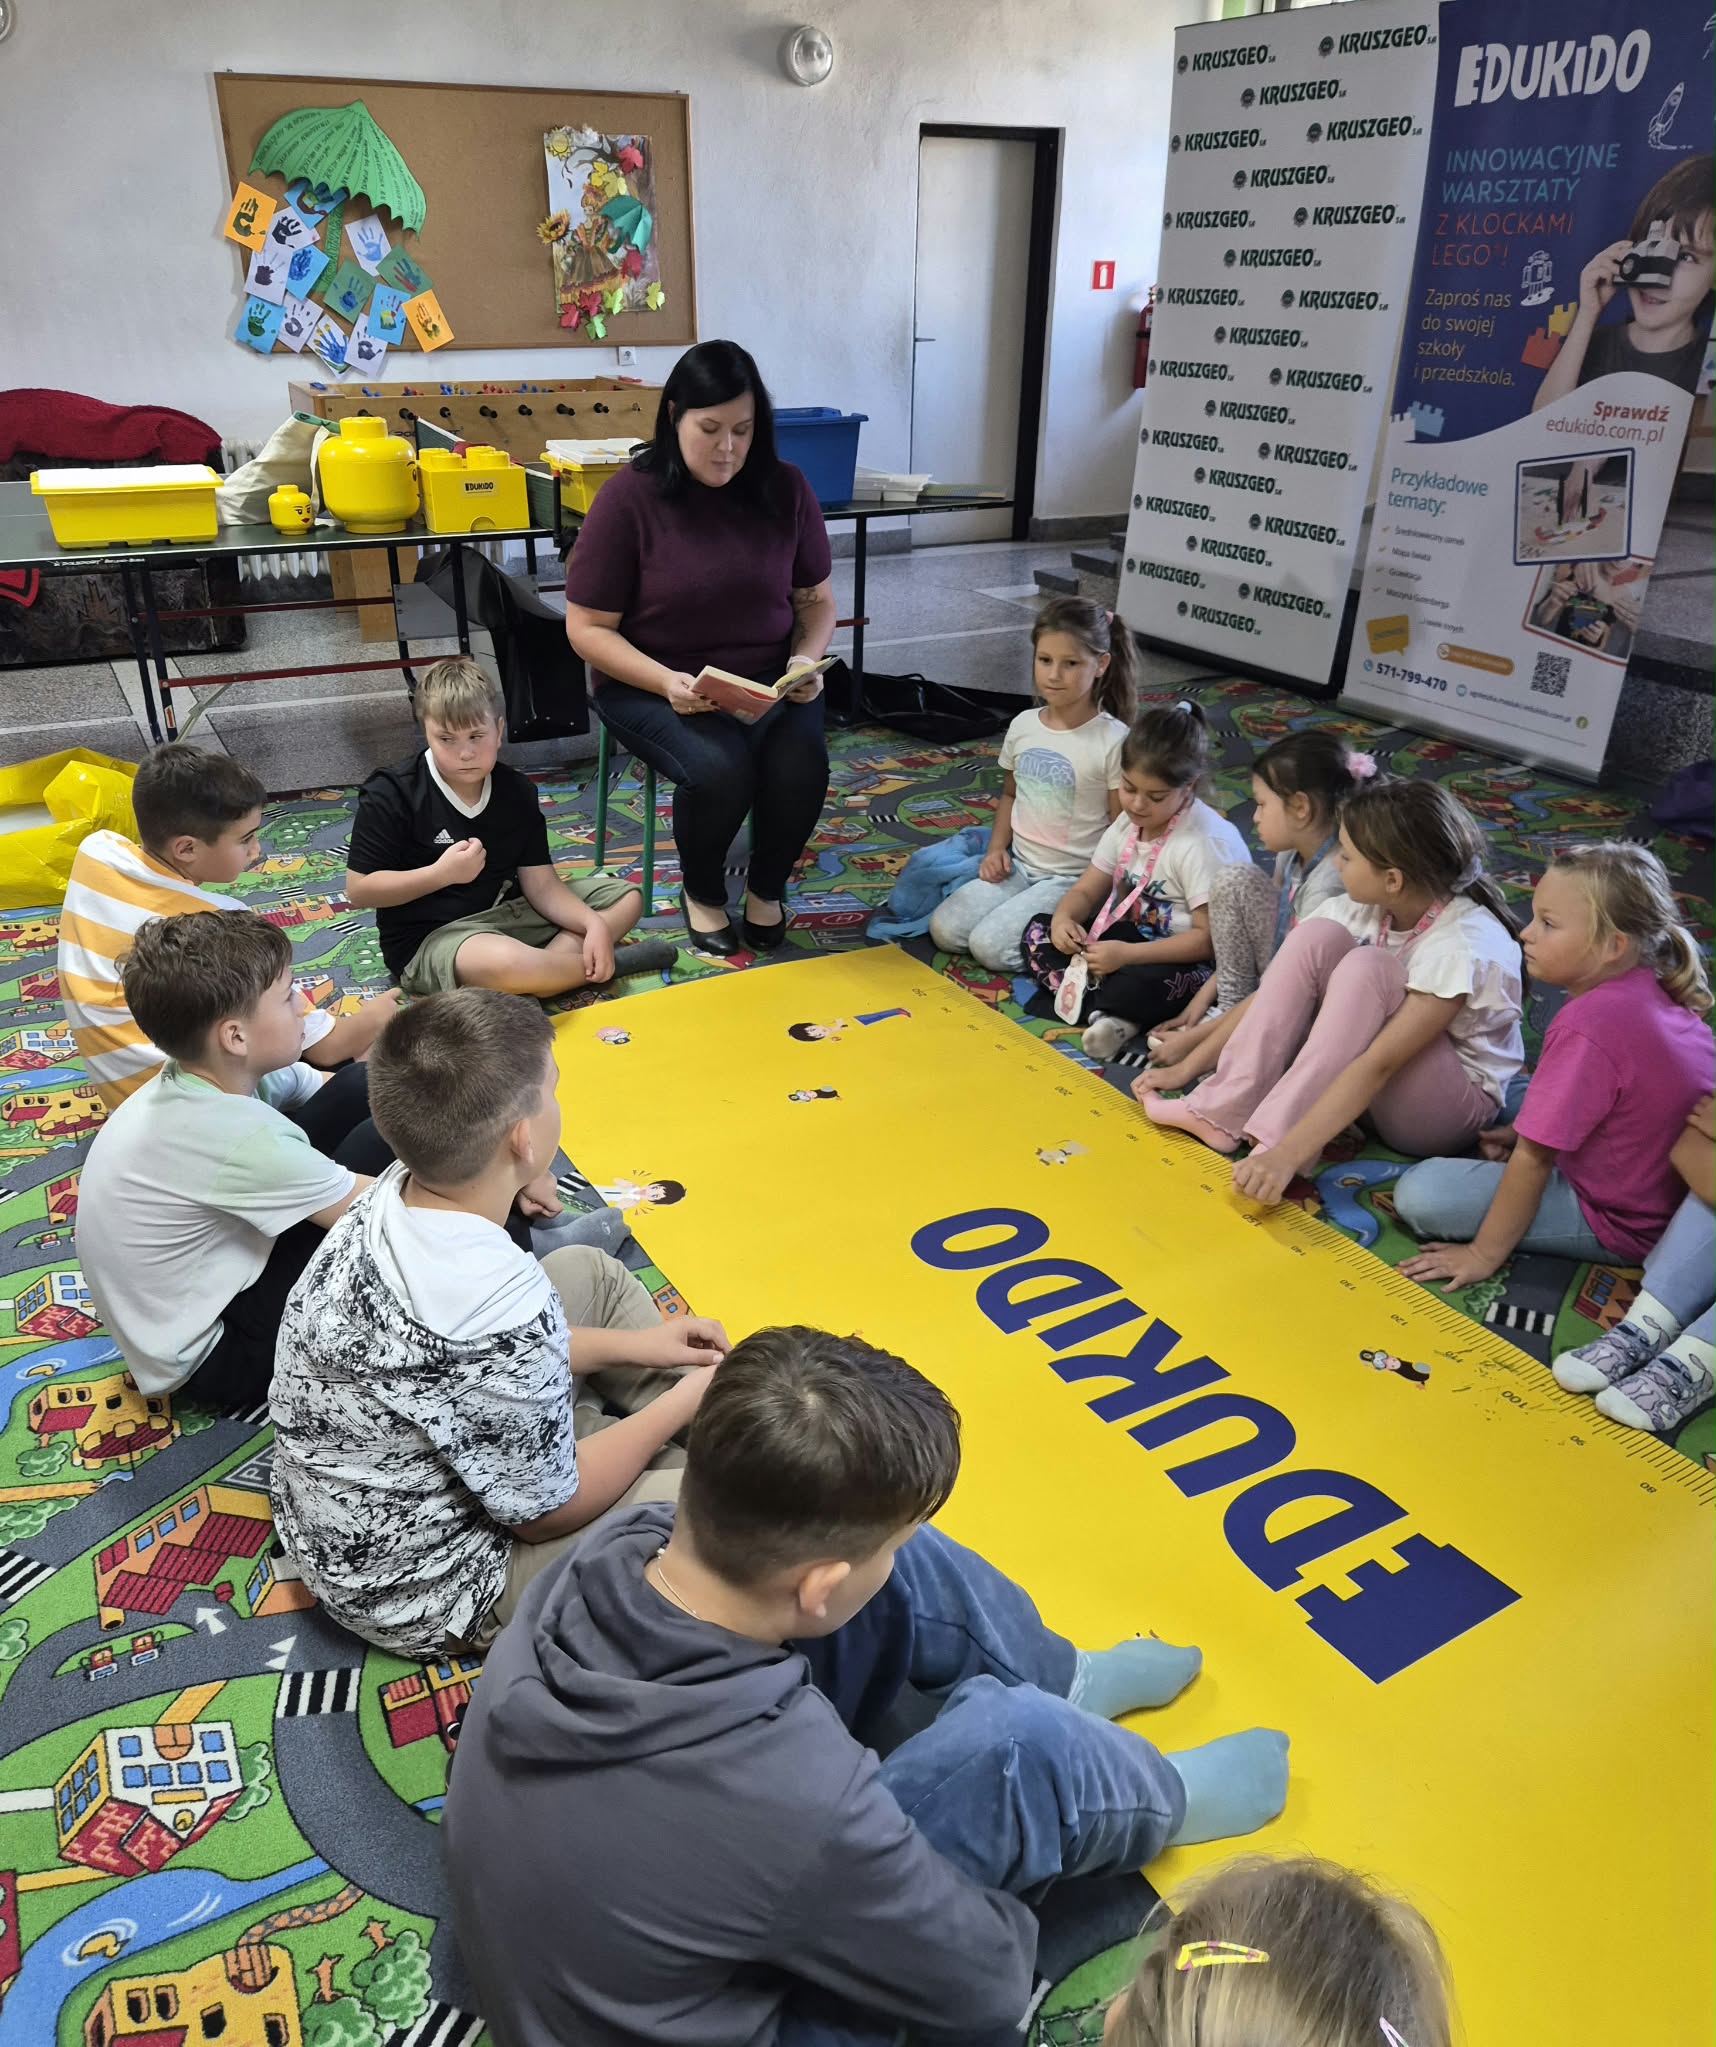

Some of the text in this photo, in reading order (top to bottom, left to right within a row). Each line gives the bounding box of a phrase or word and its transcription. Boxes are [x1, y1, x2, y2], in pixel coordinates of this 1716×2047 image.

[1339, 25, 1427, 54] KRUSZGEO
[1193, 45, 1268, 71] KRUSZGEO
[1454, 29, 1651, 107] EDUKIDO
[1260, 79, 1339, 105] KRUSZGEO
[1185, 129, 1259, 152] KRUSZGEO
[1327, 116, 1412, 141] KRUSZGEO
[1446, 144, 1621, 175] INNOWACYJNE
[1251, 165, 1328, 188] KRUSZGEO
[1442, 178, 1581, 204] WARSZTATY
[1176, 210, 1249, 230] KRUSZGEO
[1313, 205, 1395, 227] KRUSZGEO
[1435, 212, 1575, 236] Z KLOCKAMI
[1240, 249, 1314, 268] KRUSZGEO
[1168, 288, 1238, 306] KRUSZGEO
[1299, 290, 1378, 310] KRUSZGEO
[1425, 288, 1513, 310] Zaproś nas
[1230, 327, 1301, 347] KRUSZGEO
[1422, 313, 1496, 338] do swojej
[1418, 338, 1465, 361] szkoły
[1160, 360, 1228, 380] KRUSZGEO
[1286, 369, 1363, 392] KRUSZGEO
[1414, 361, 1516, 387] i przedszkola.
[1220, 401, 1289, 424] KRUSZGEO
[1593, 400, 1670, 423] Sprawdź
[1152, 430, 1218, 452] KRUSZGEO
[1546, 417, 1665, 445] edukido.com.pl
[1274, 444, 1348, 470] KRUSZGEO
[464, 481, 494, 492] EDUKIDO
[1209, 469, 1276, 494] KRUSZGEO
[1391, 467, 1489, 496] Przykładowe
[1146, 496, 1210, 520] KRUSZGEO
[1388, 491, 1447, 518] tematy:
[1265, 516, 1337, 544] KRUSZGEO
[1201, 538, 1266, 565] KRUSZGEO
[1139, 561, 1200, 587] KRUSZGEO
[1254, 586, 1324, 616] KRUSZGEO
[1191, 604, 1256, 633] KRUSZGEO
[1376, 662, 1448, 692] 571-799-470
[1241, 1213, 1263, 1227] 150
[1339, 1279, 1357, 1291] 130
[1390, 1313, 1409, 1326] 120
[1501, 1390, 1528, 1409] 100
[911, 1208, 1522, 1684] EDUKIDO
[1570, 1435, 1586, 1446] 90
[1639, 1482, 1657, 1494] 80
